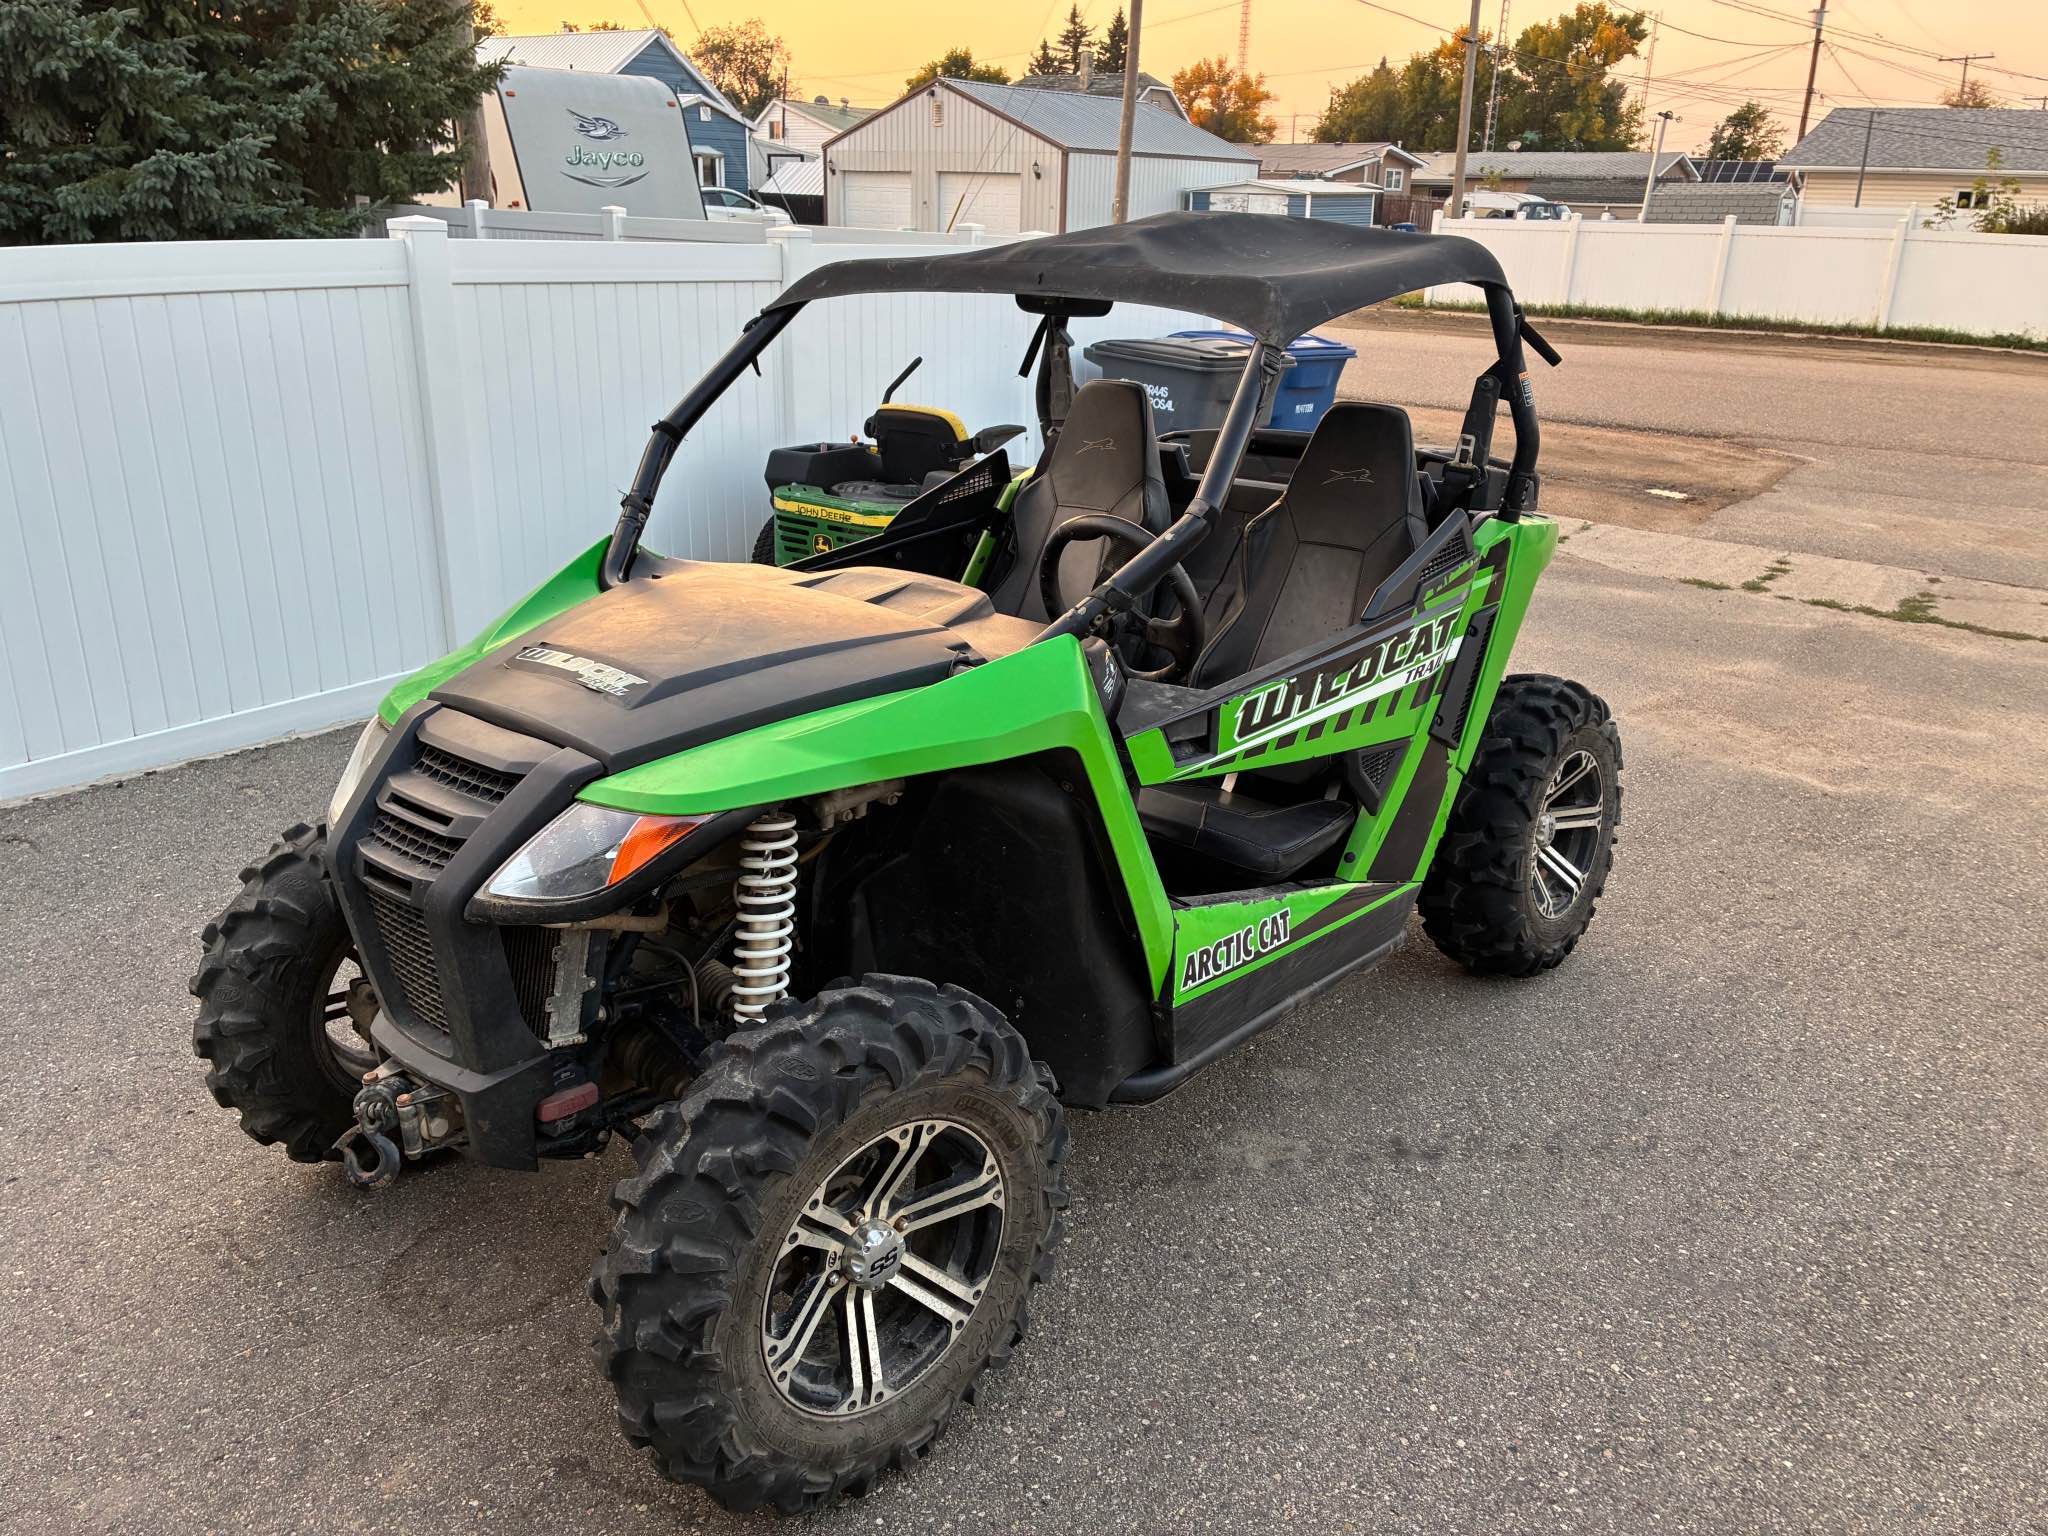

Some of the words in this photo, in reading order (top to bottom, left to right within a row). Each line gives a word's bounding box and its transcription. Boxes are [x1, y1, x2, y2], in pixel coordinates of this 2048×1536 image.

[565, 144, 645, 170] Jayco
[795, 504, 819, 517] JOHN
[821, 508, 852, 524] DEERE
[1234, 606, 1464, 743] WILDCAT
[1404, 652, 1444, 685] TRAIL
[1180, 924, 1255, 992] ARCTIC
[1258, 906, 1291, 953] CAT
